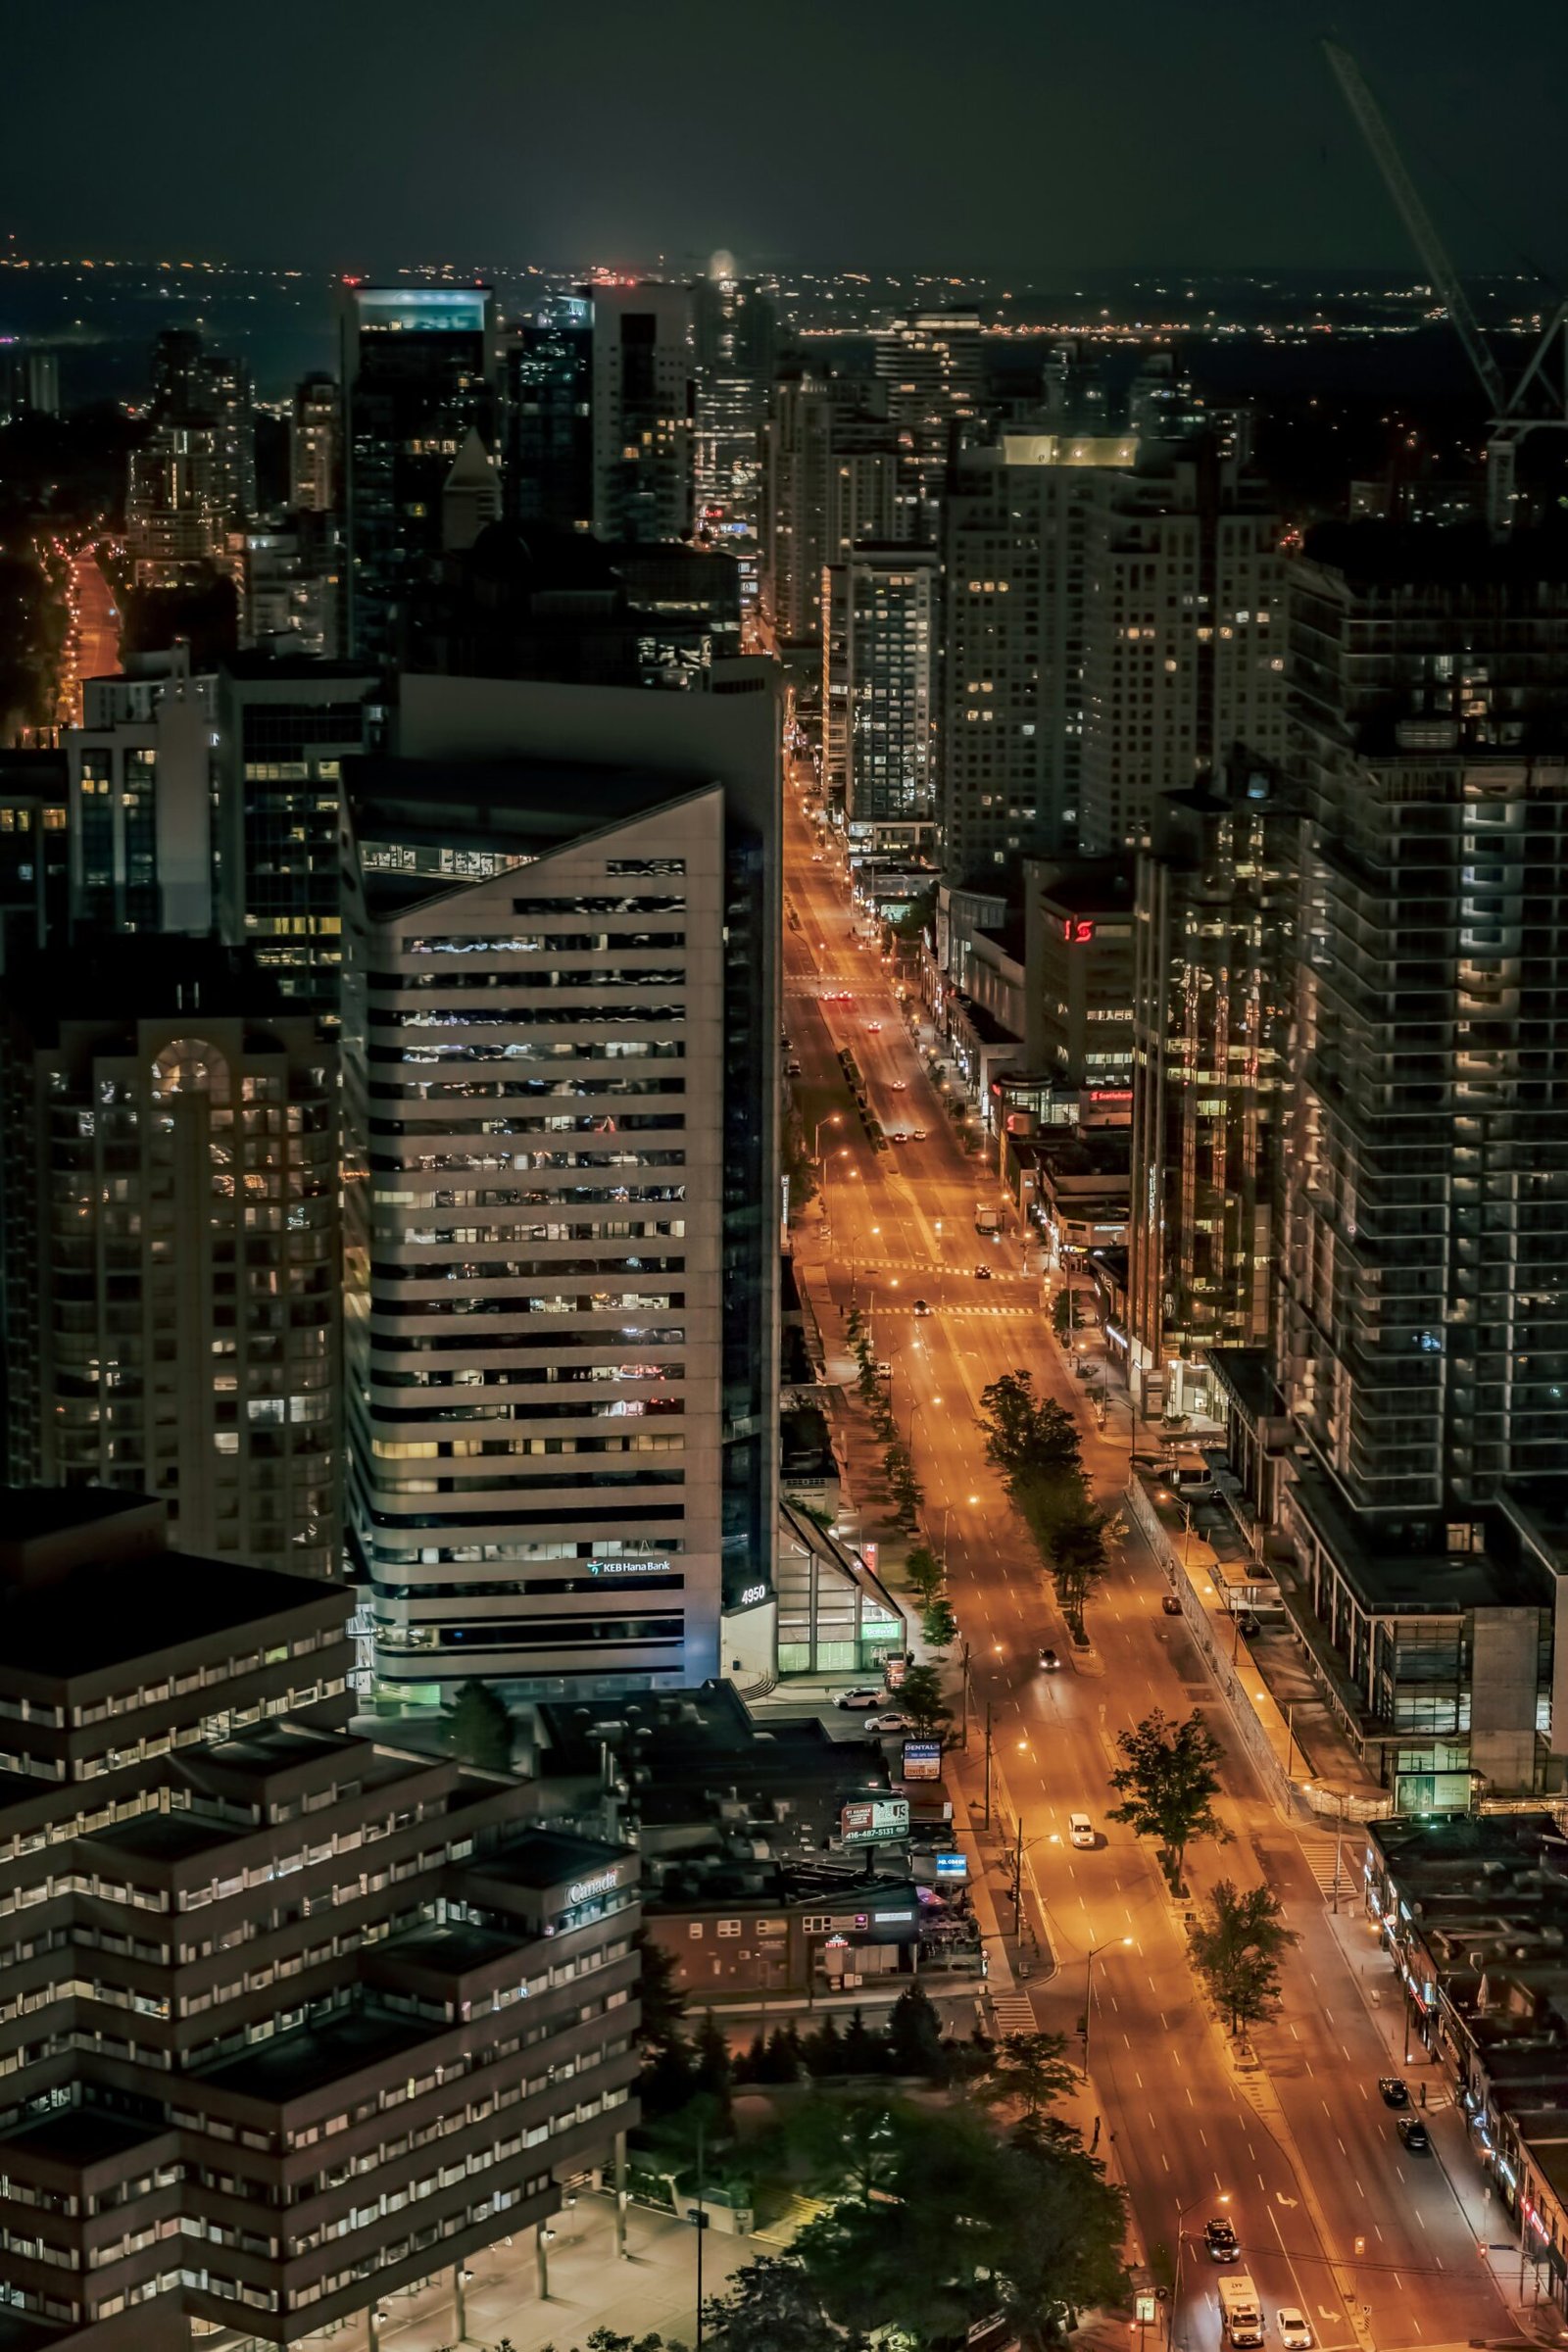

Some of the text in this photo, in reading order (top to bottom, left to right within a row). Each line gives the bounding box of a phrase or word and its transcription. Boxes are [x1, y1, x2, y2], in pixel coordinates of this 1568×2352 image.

[603, 1561, 670, 1573] KEB Hana Bank
[741, 1585, 765, 1604] 4950
[846, 1828, 894, 1839] 416-487-5131
[570, 1871, 616, 1902] Canada
